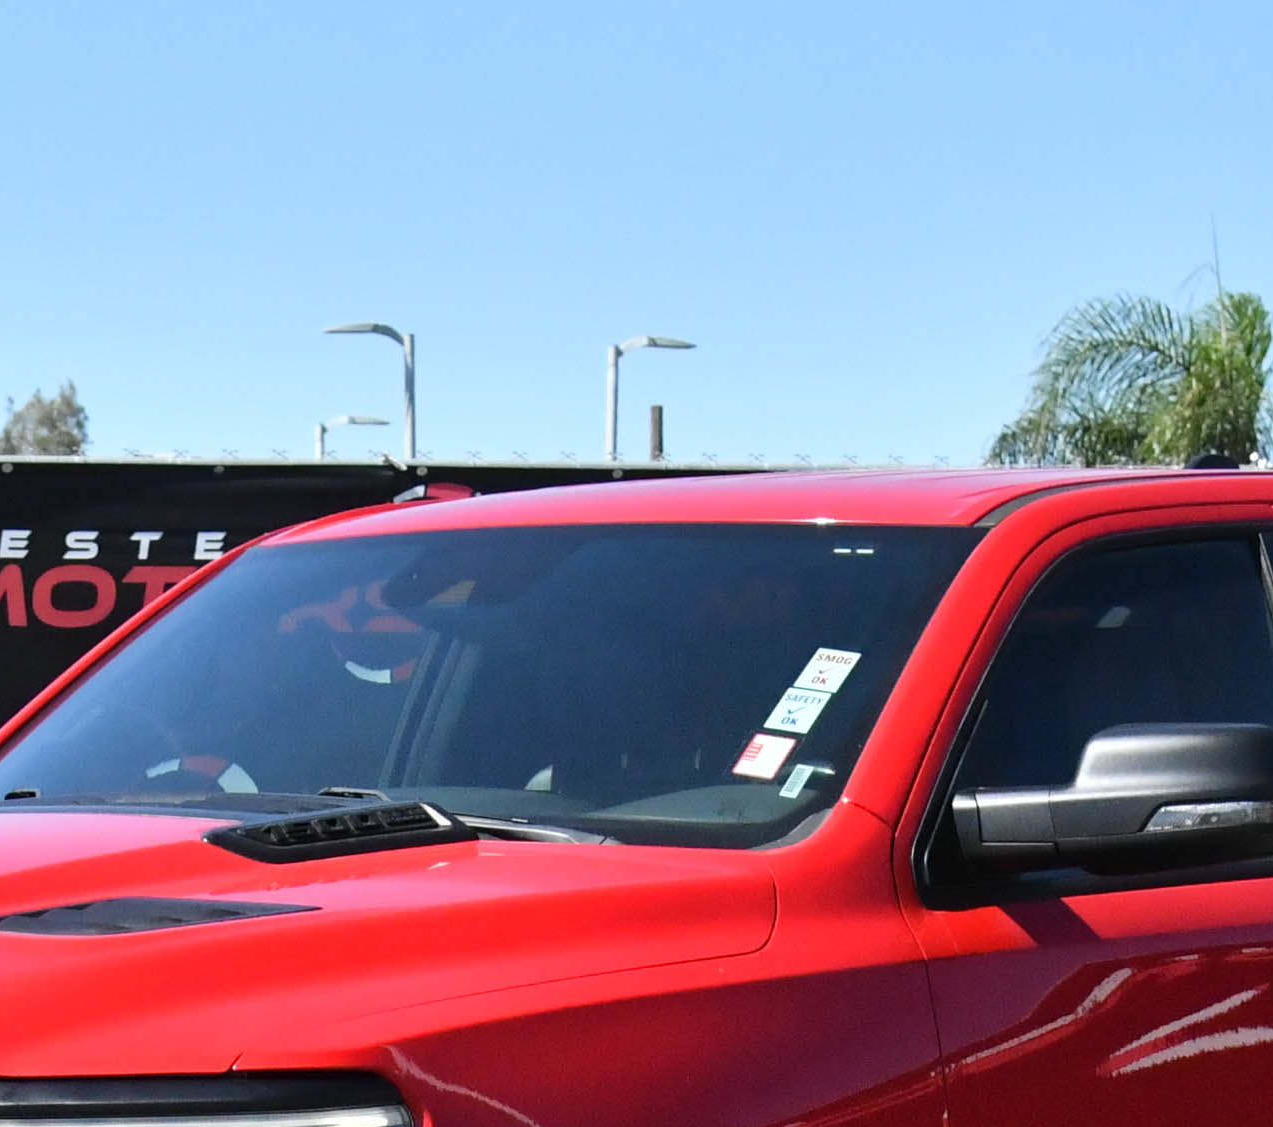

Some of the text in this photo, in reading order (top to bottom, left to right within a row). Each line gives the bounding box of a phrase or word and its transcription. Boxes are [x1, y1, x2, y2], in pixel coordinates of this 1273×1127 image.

[817, 654, 853, 665] SMOG
[811, 677, 828, 685] OK
[785, 694, 823, 705] SAFETY
[782, 717, 798, 725] OK
